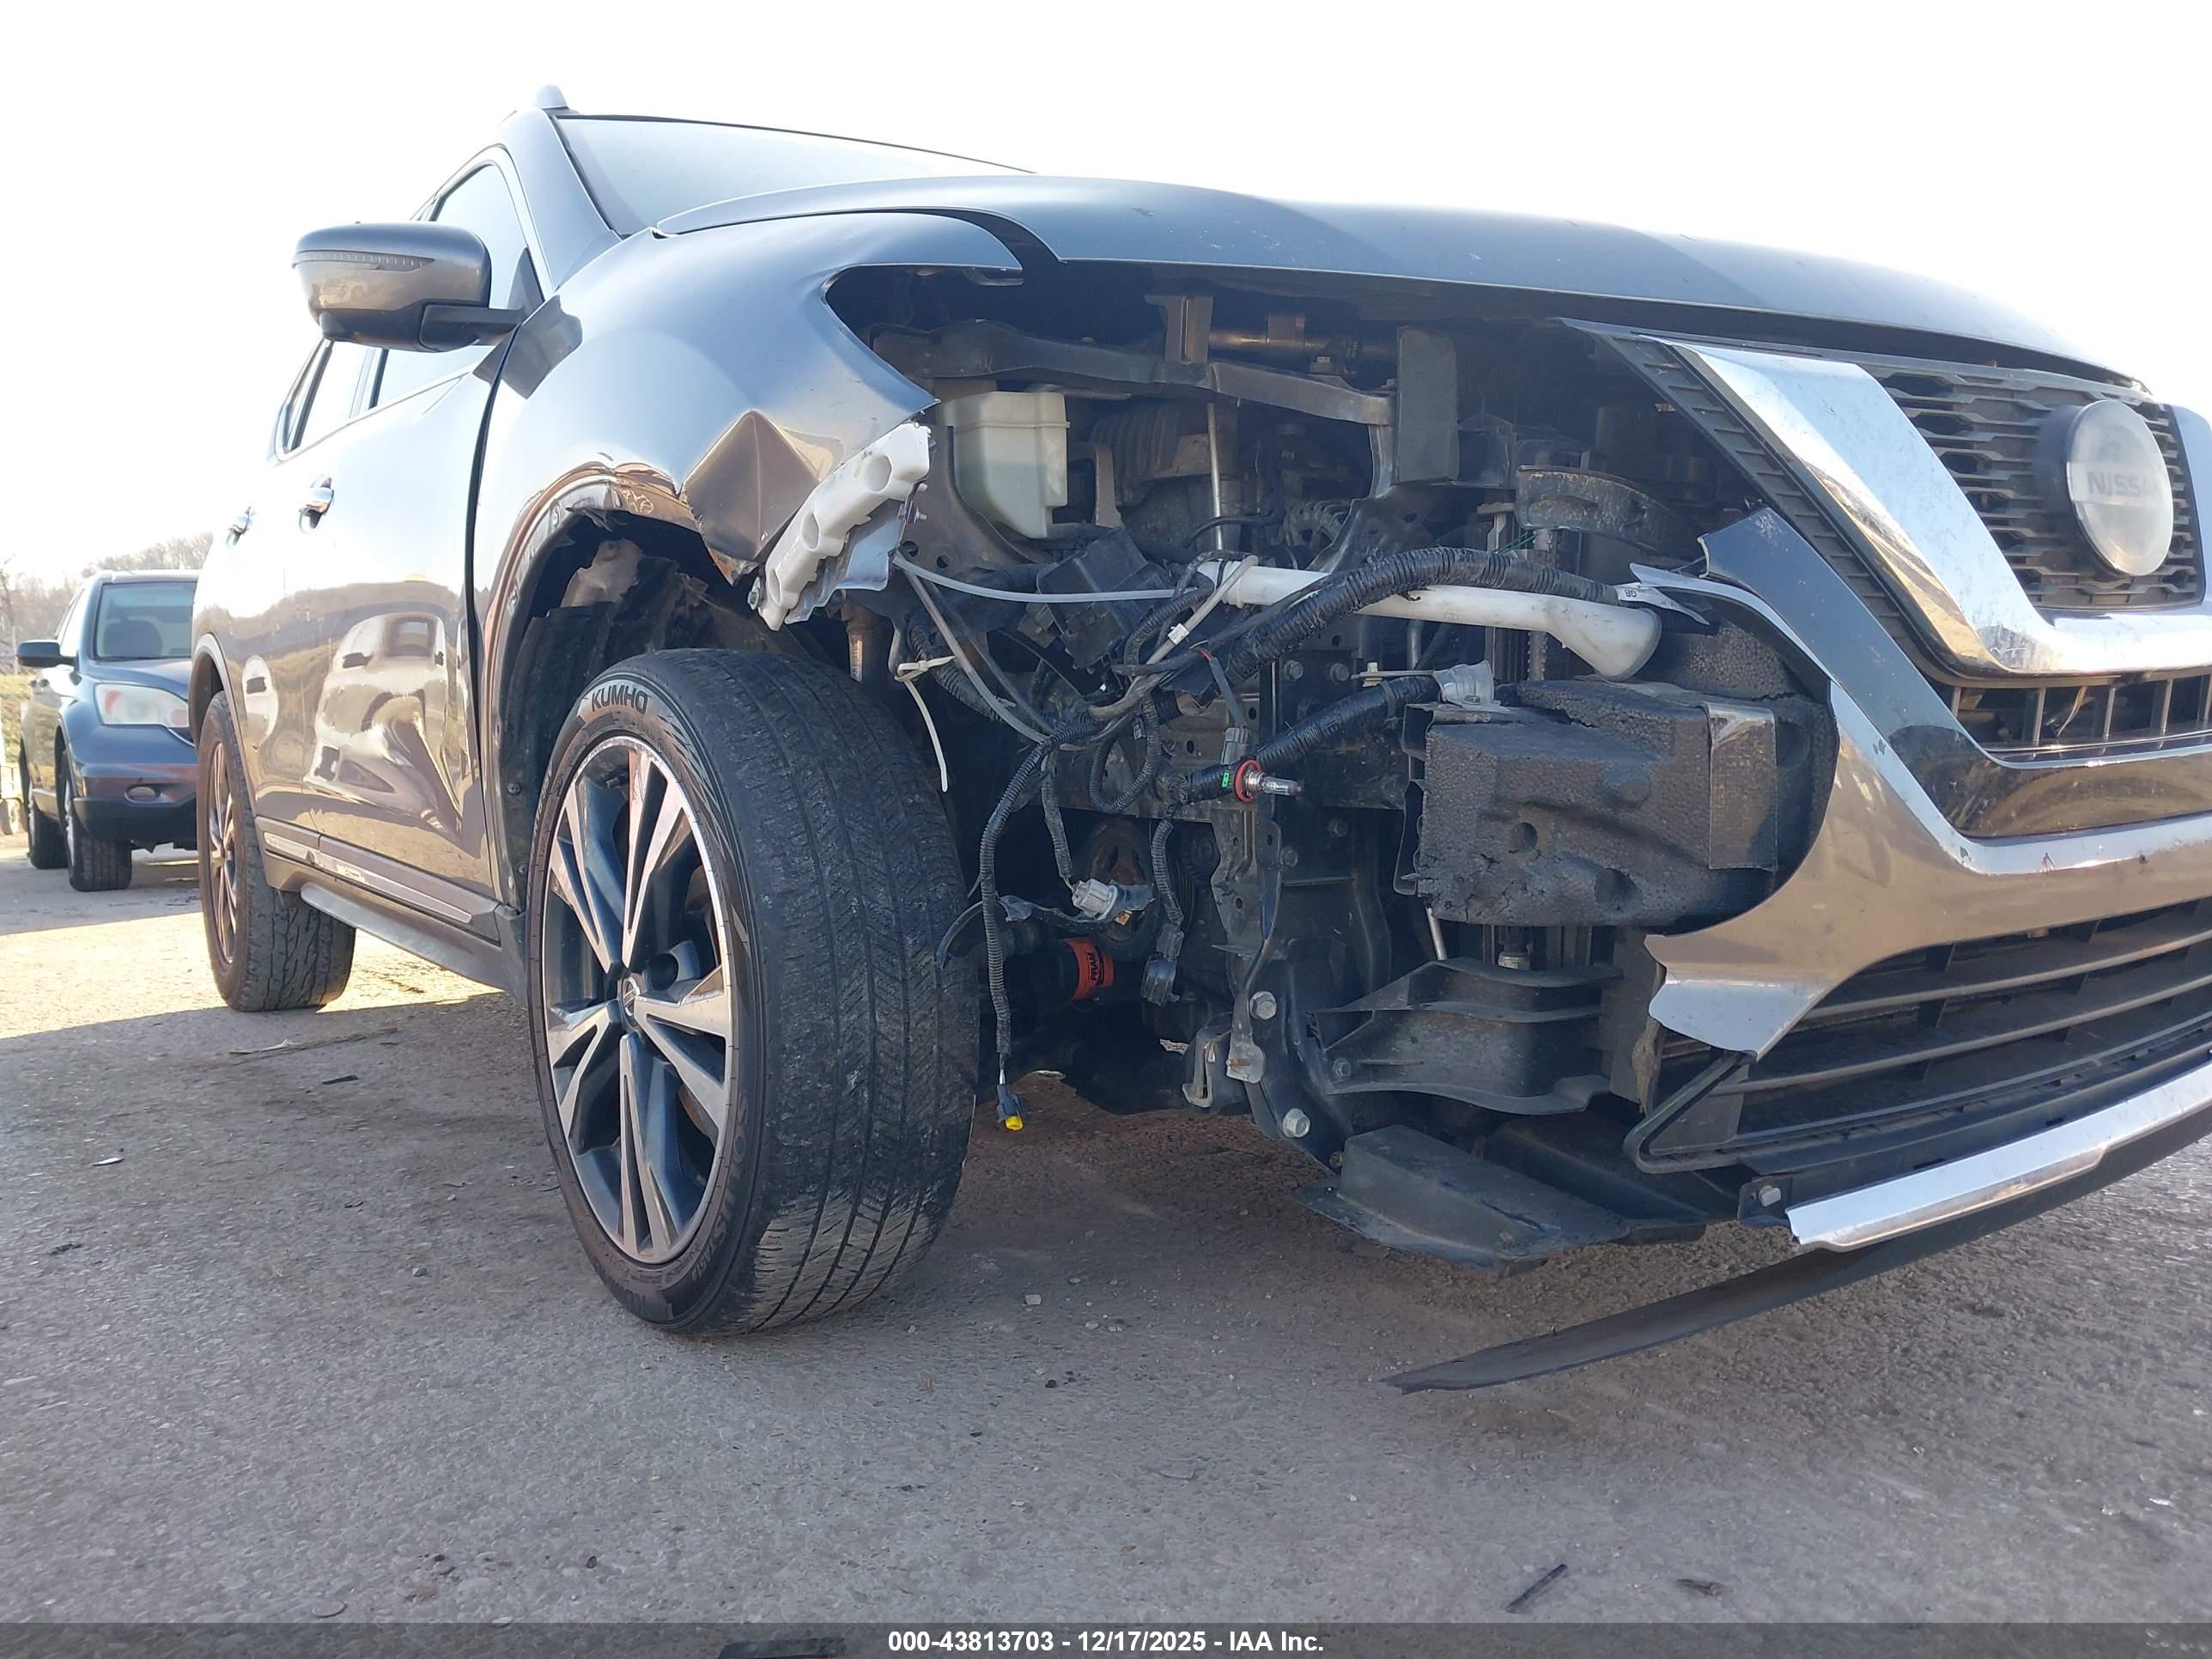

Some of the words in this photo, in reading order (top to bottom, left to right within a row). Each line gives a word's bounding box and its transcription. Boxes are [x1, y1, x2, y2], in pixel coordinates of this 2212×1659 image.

[591, 684, 648, 715] KUMHO
[1085, 952, 1099, 981] FRAM
[714, 1093, 750, 1245] SOLUS
